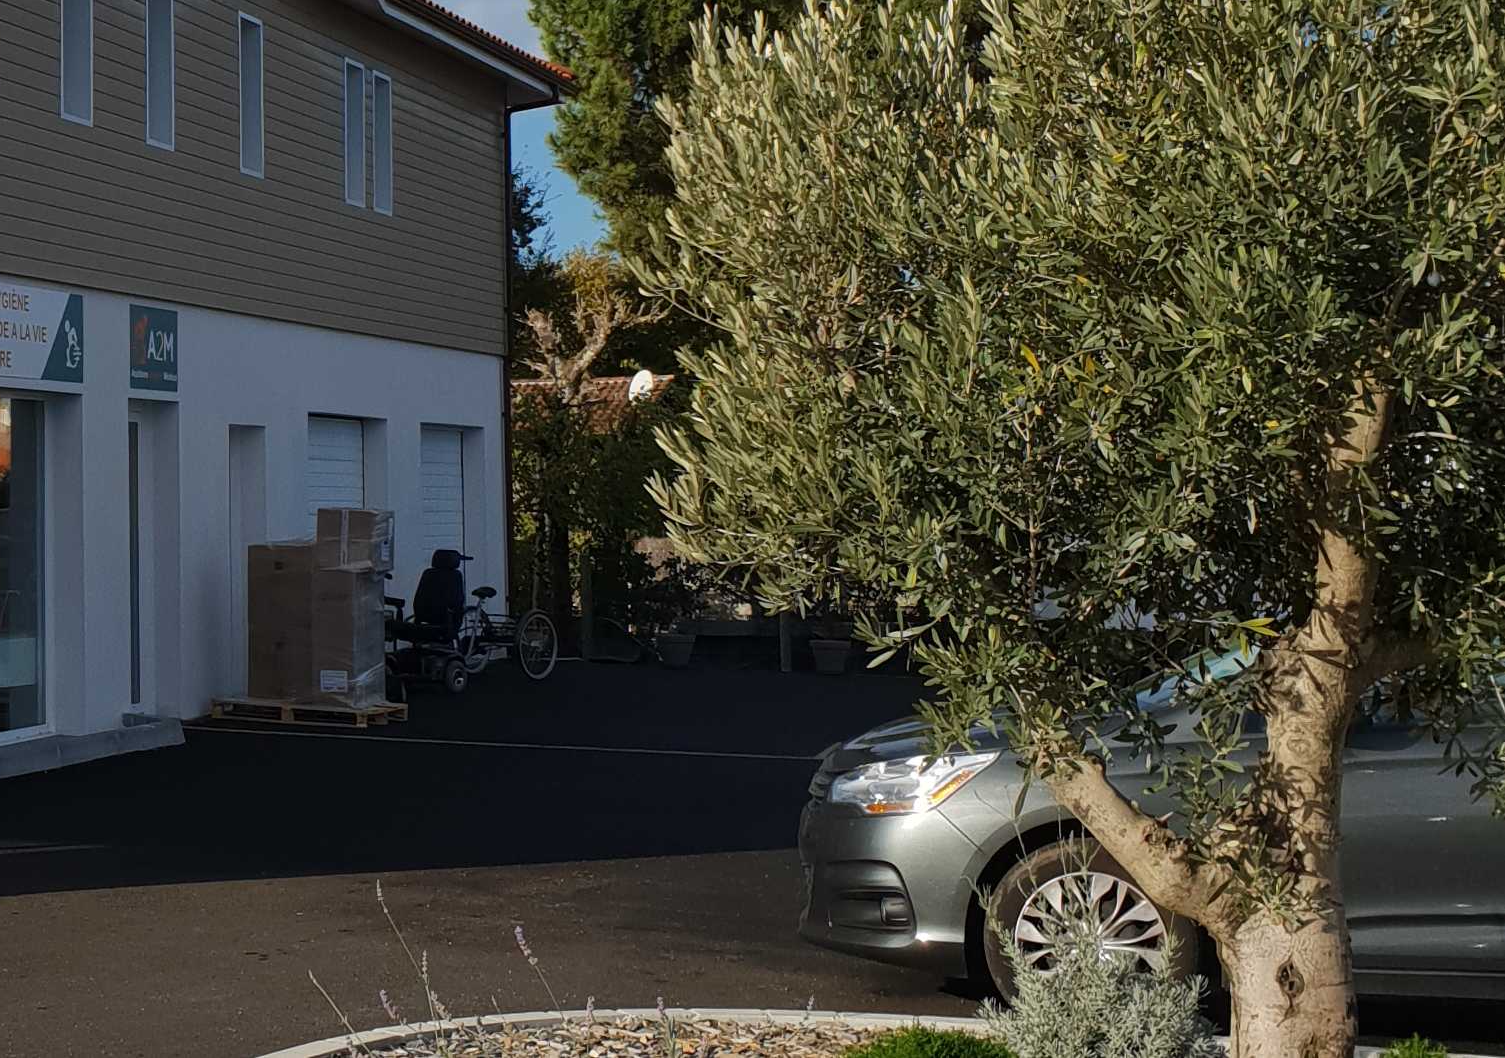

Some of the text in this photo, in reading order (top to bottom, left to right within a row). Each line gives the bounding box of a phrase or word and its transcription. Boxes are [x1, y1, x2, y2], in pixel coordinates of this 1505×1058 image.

[20, 324, 31, 341] LA
[32, 325, 48, 343] VIE
[147, 329, 174, 363] A2M
